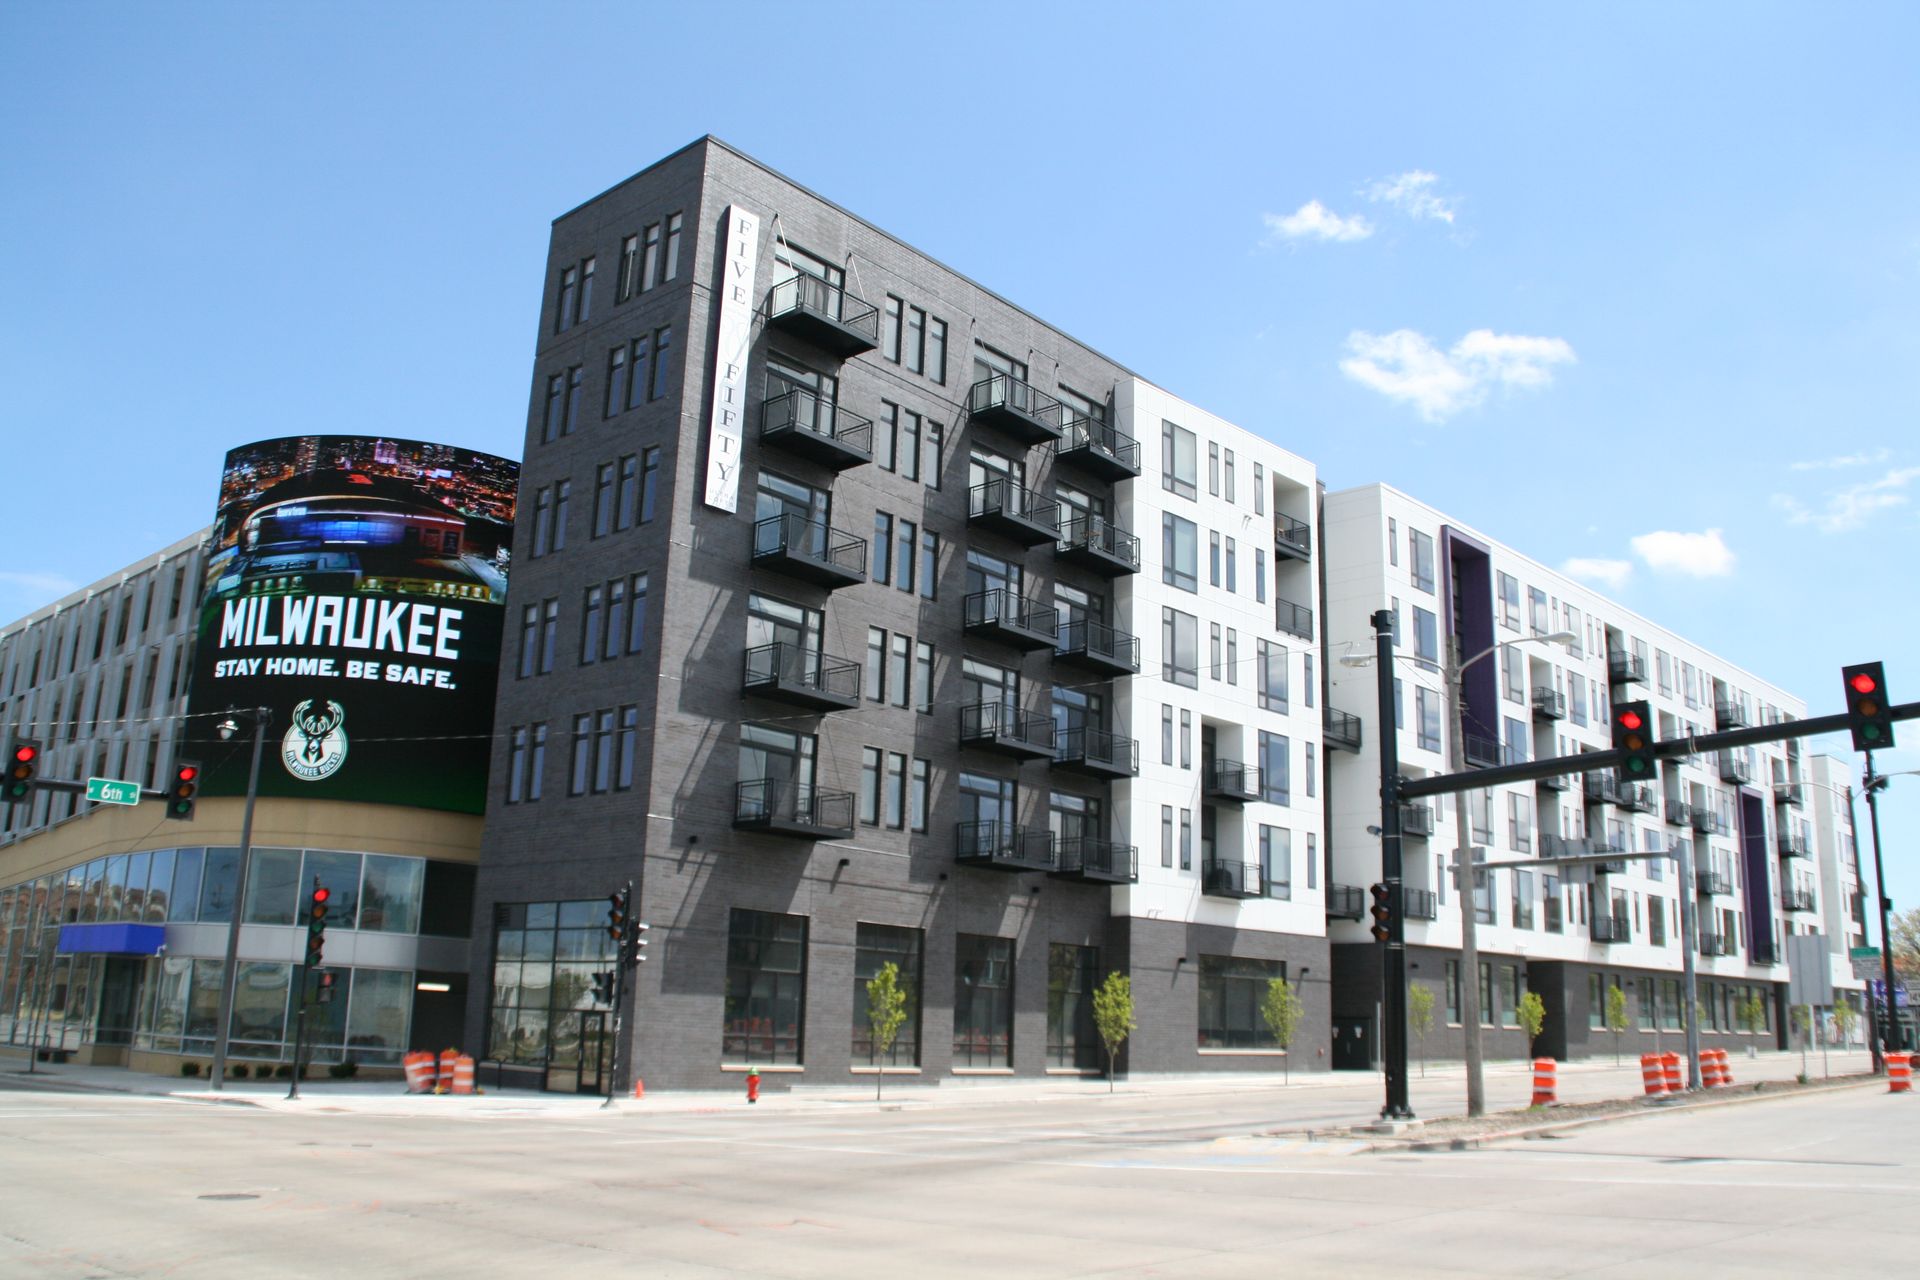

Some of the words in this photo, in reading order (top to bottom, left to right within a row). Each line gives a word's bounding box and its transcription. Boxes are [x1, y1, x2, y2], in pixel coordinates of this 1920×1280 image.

[730, 217, 752, 305] FIVE
[715, 361, 740, 482] FIFTY
[219, 595, 463, 660] MILWAUKEE
[214, 658, 262, 678] STAY
[265, 658, 340, 677] HOME.
[345, 660, 381, 680] BE
[385, 664, 456, 690] SAFE.
[101, 783, 123, 800] 6th
